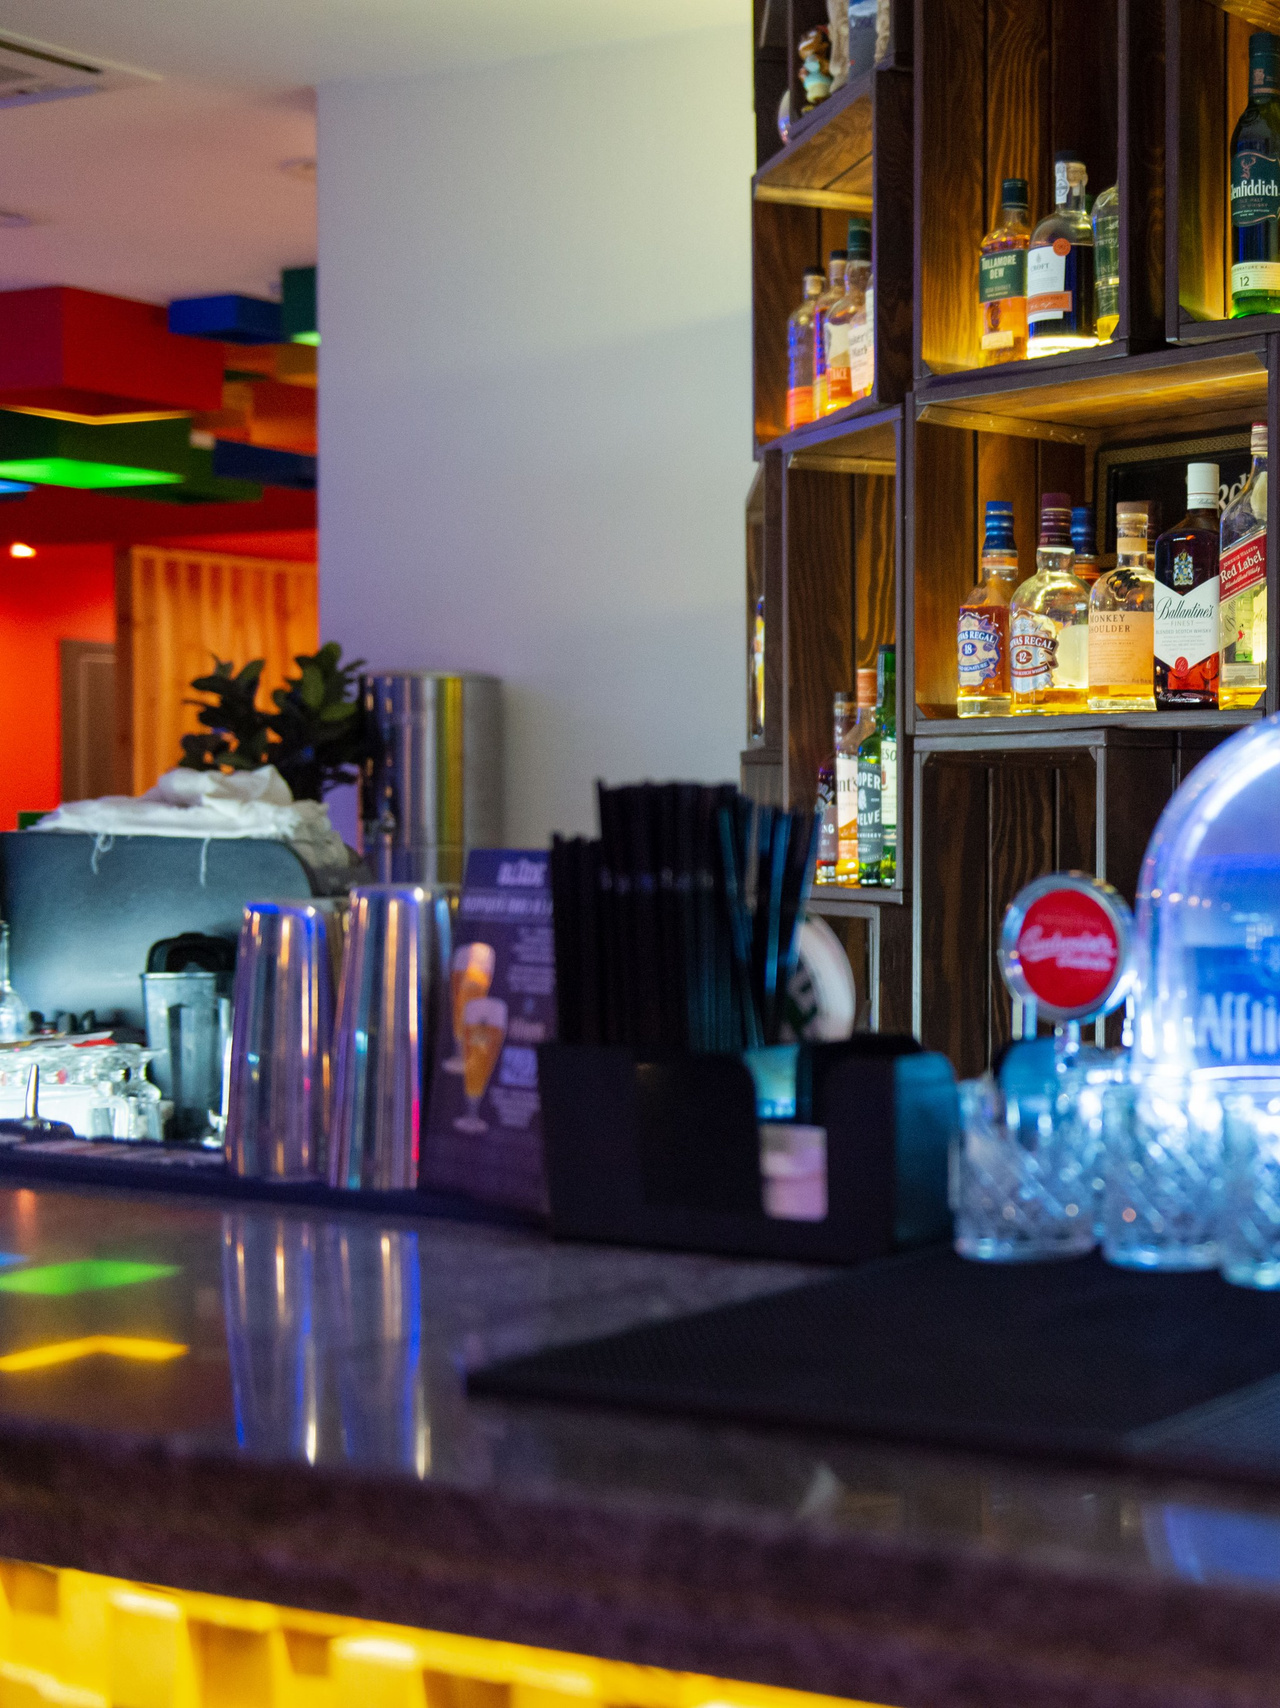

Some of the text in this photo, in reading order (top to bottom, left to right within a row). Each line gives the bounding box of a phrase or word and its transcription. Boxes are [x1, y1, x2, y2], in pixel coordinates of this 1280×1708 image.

[989, 267, 1005, 280] DEW
[1240, 276, 1250, 287] 12
[1220, 564, 1238, 584] Red
[1155, 596, 1215, 621] Ballantine's
[969, 630, 995, 644] REGAL
[1024, 636, 1055, 650] REGAL
[1019, 651, 1027, 662] 12
[839, 776, 858, 792] nt's
